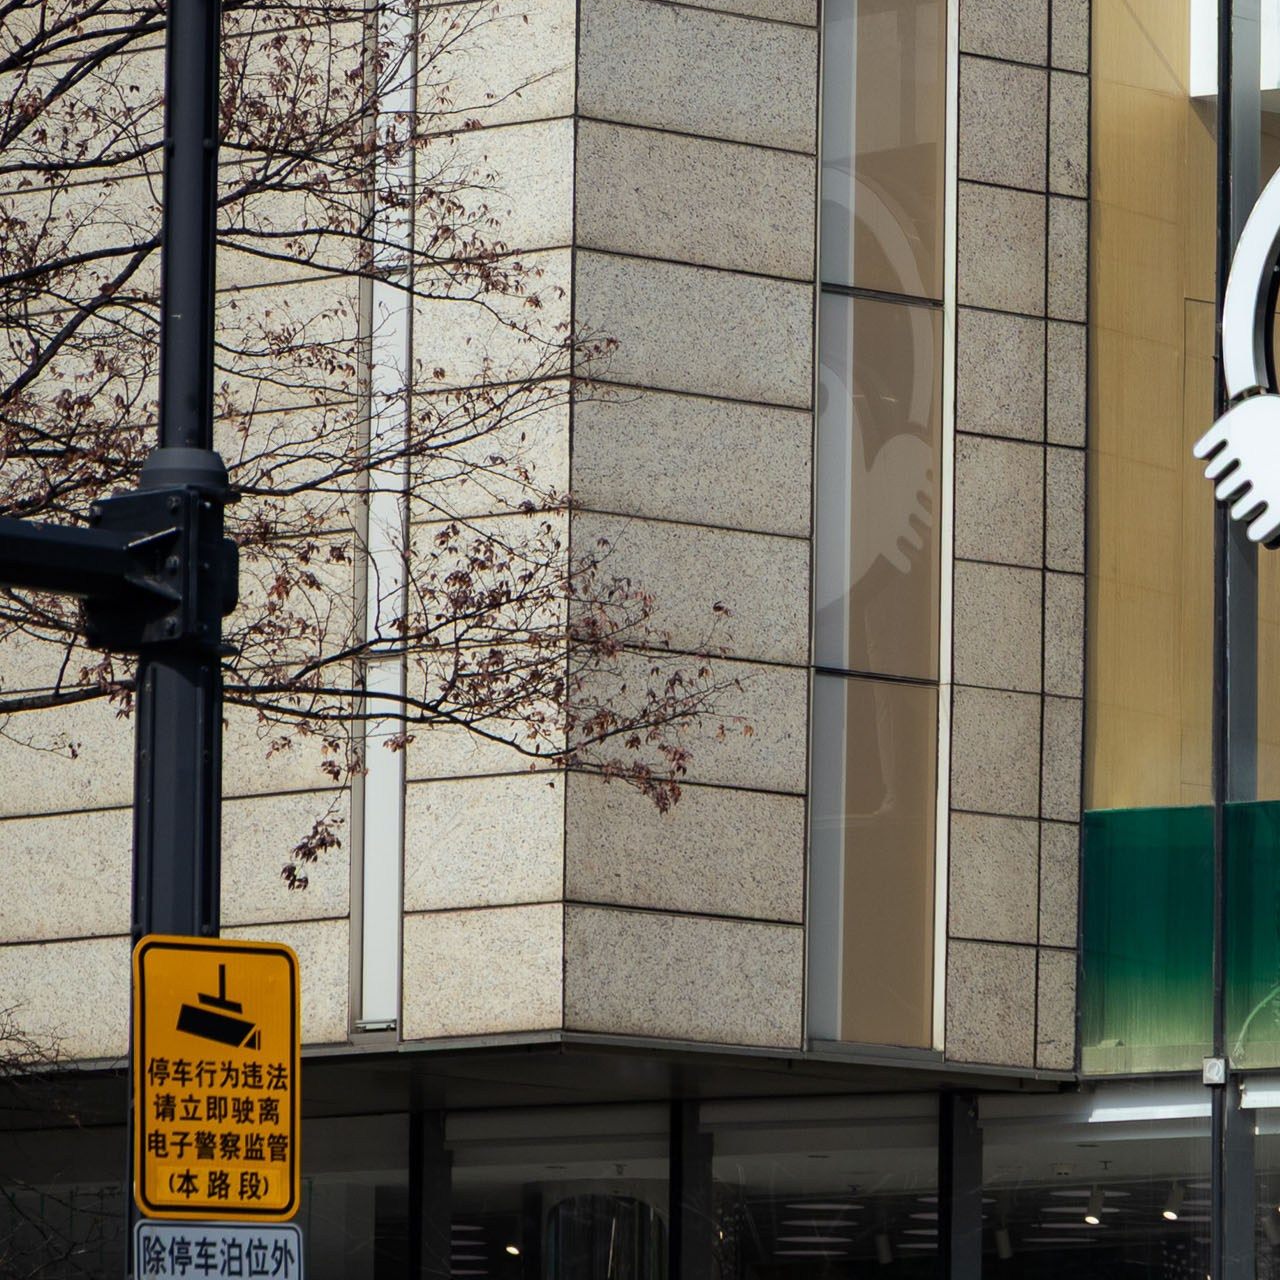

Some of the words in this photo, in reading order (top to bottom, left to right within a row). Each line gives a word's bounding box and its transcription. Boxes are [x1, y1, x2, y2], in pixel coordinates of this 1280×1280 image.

[147, 1057, 289, 1093] 停车行为违法
[153, 1093, 281, 1126] 请立即驶离
[147, 1131, 289, 1163] 电子警察监管
[168, 1169, 270, 1201] (本路段)
[142, 1235, 295, 1280] 除停车泊位外
